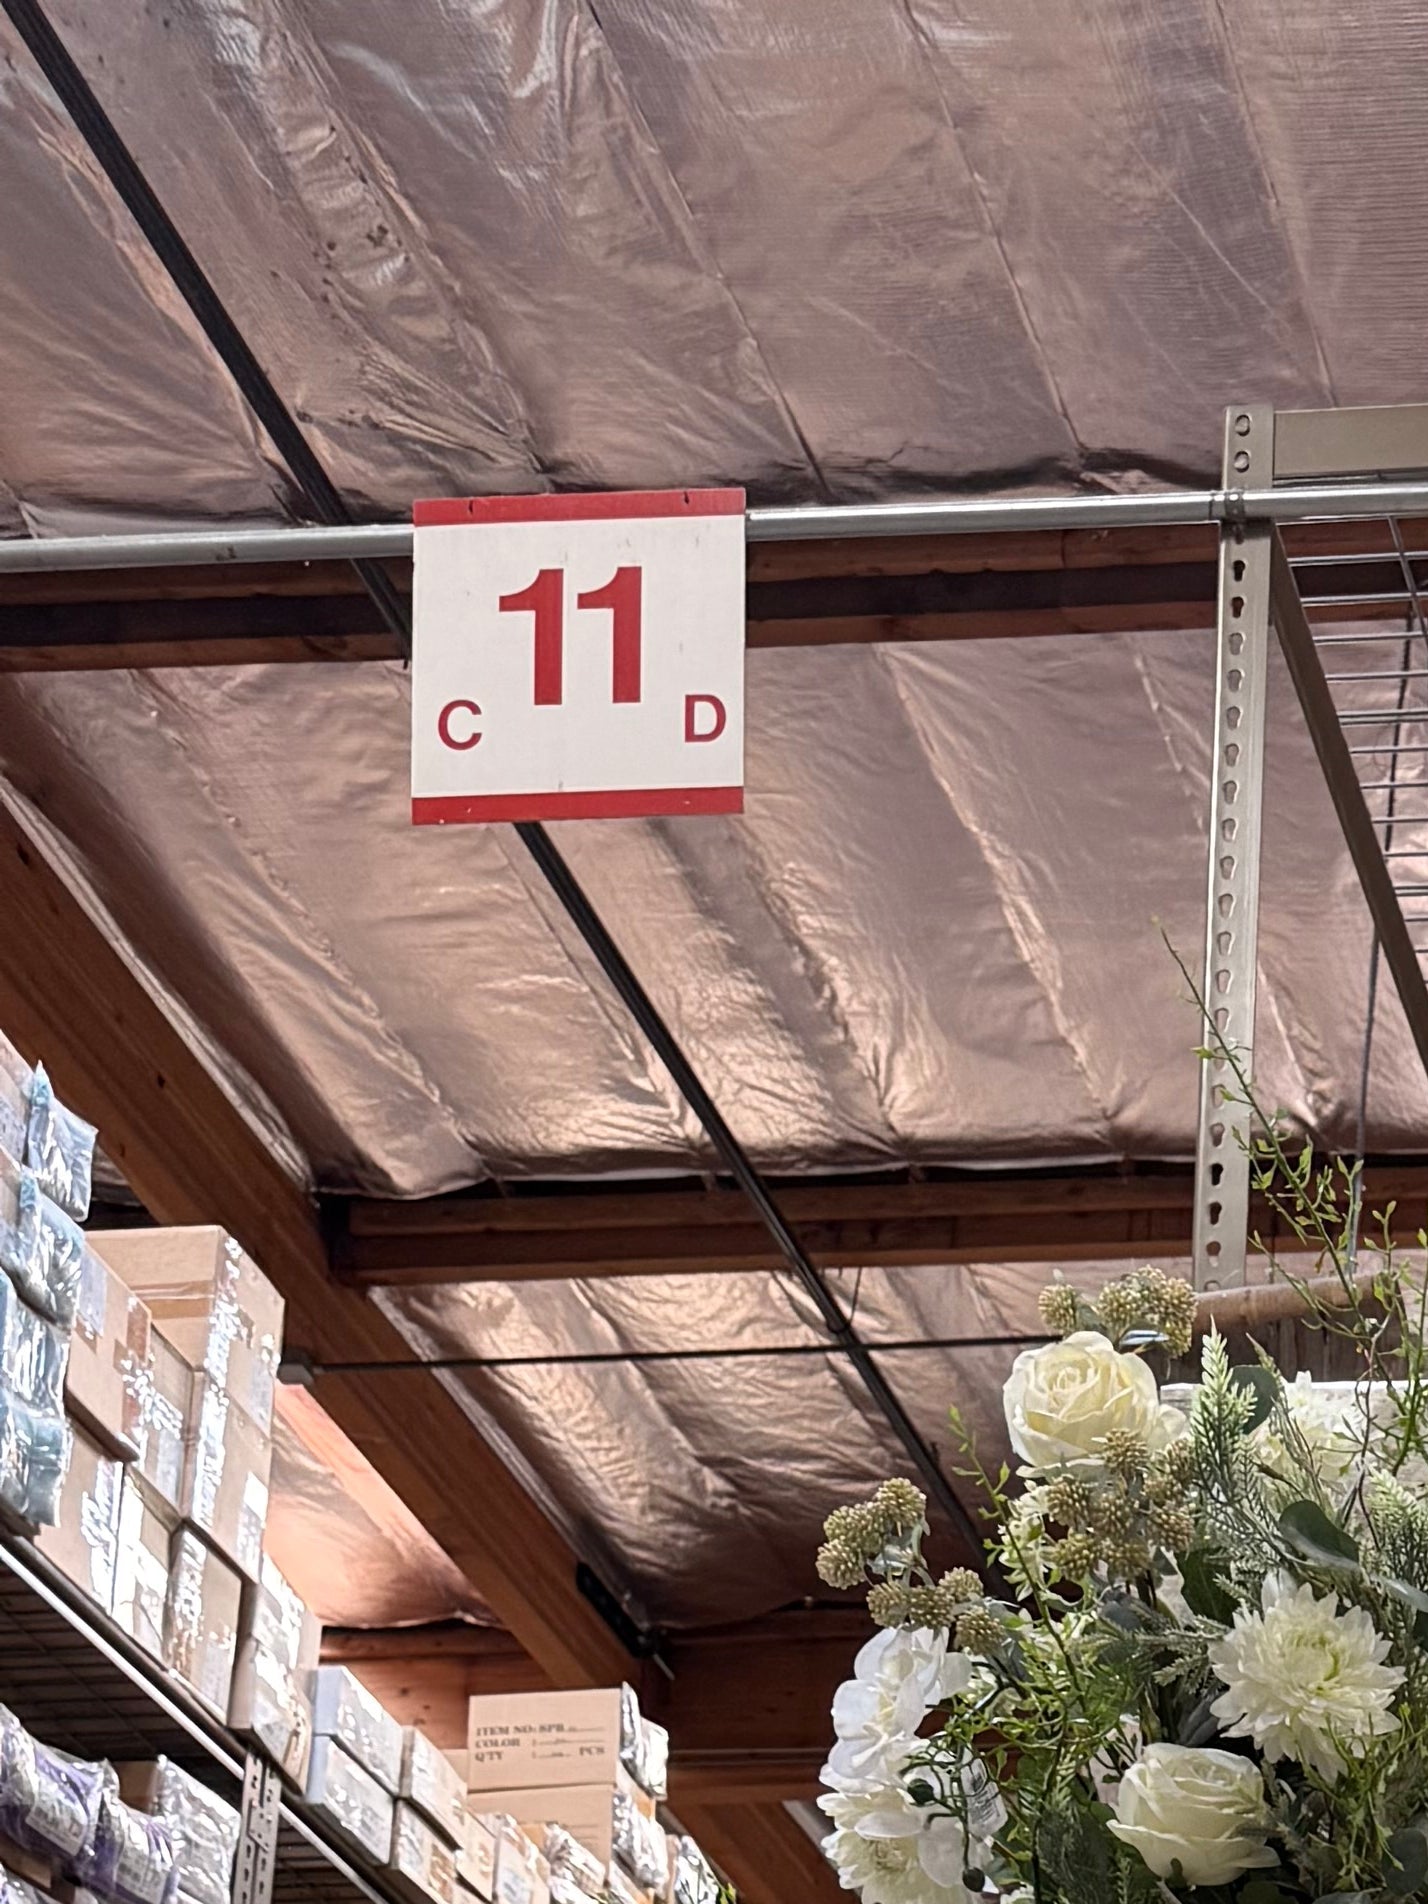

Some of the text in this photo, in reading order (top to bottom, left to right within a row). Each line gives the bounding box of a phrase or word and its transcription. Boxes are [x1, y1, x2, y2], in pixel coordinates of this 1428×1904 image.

[499, 566, 642, 706] 11
[437, 694, 727, 751] C D
[476, 1725, 510, 1738] ITEM
